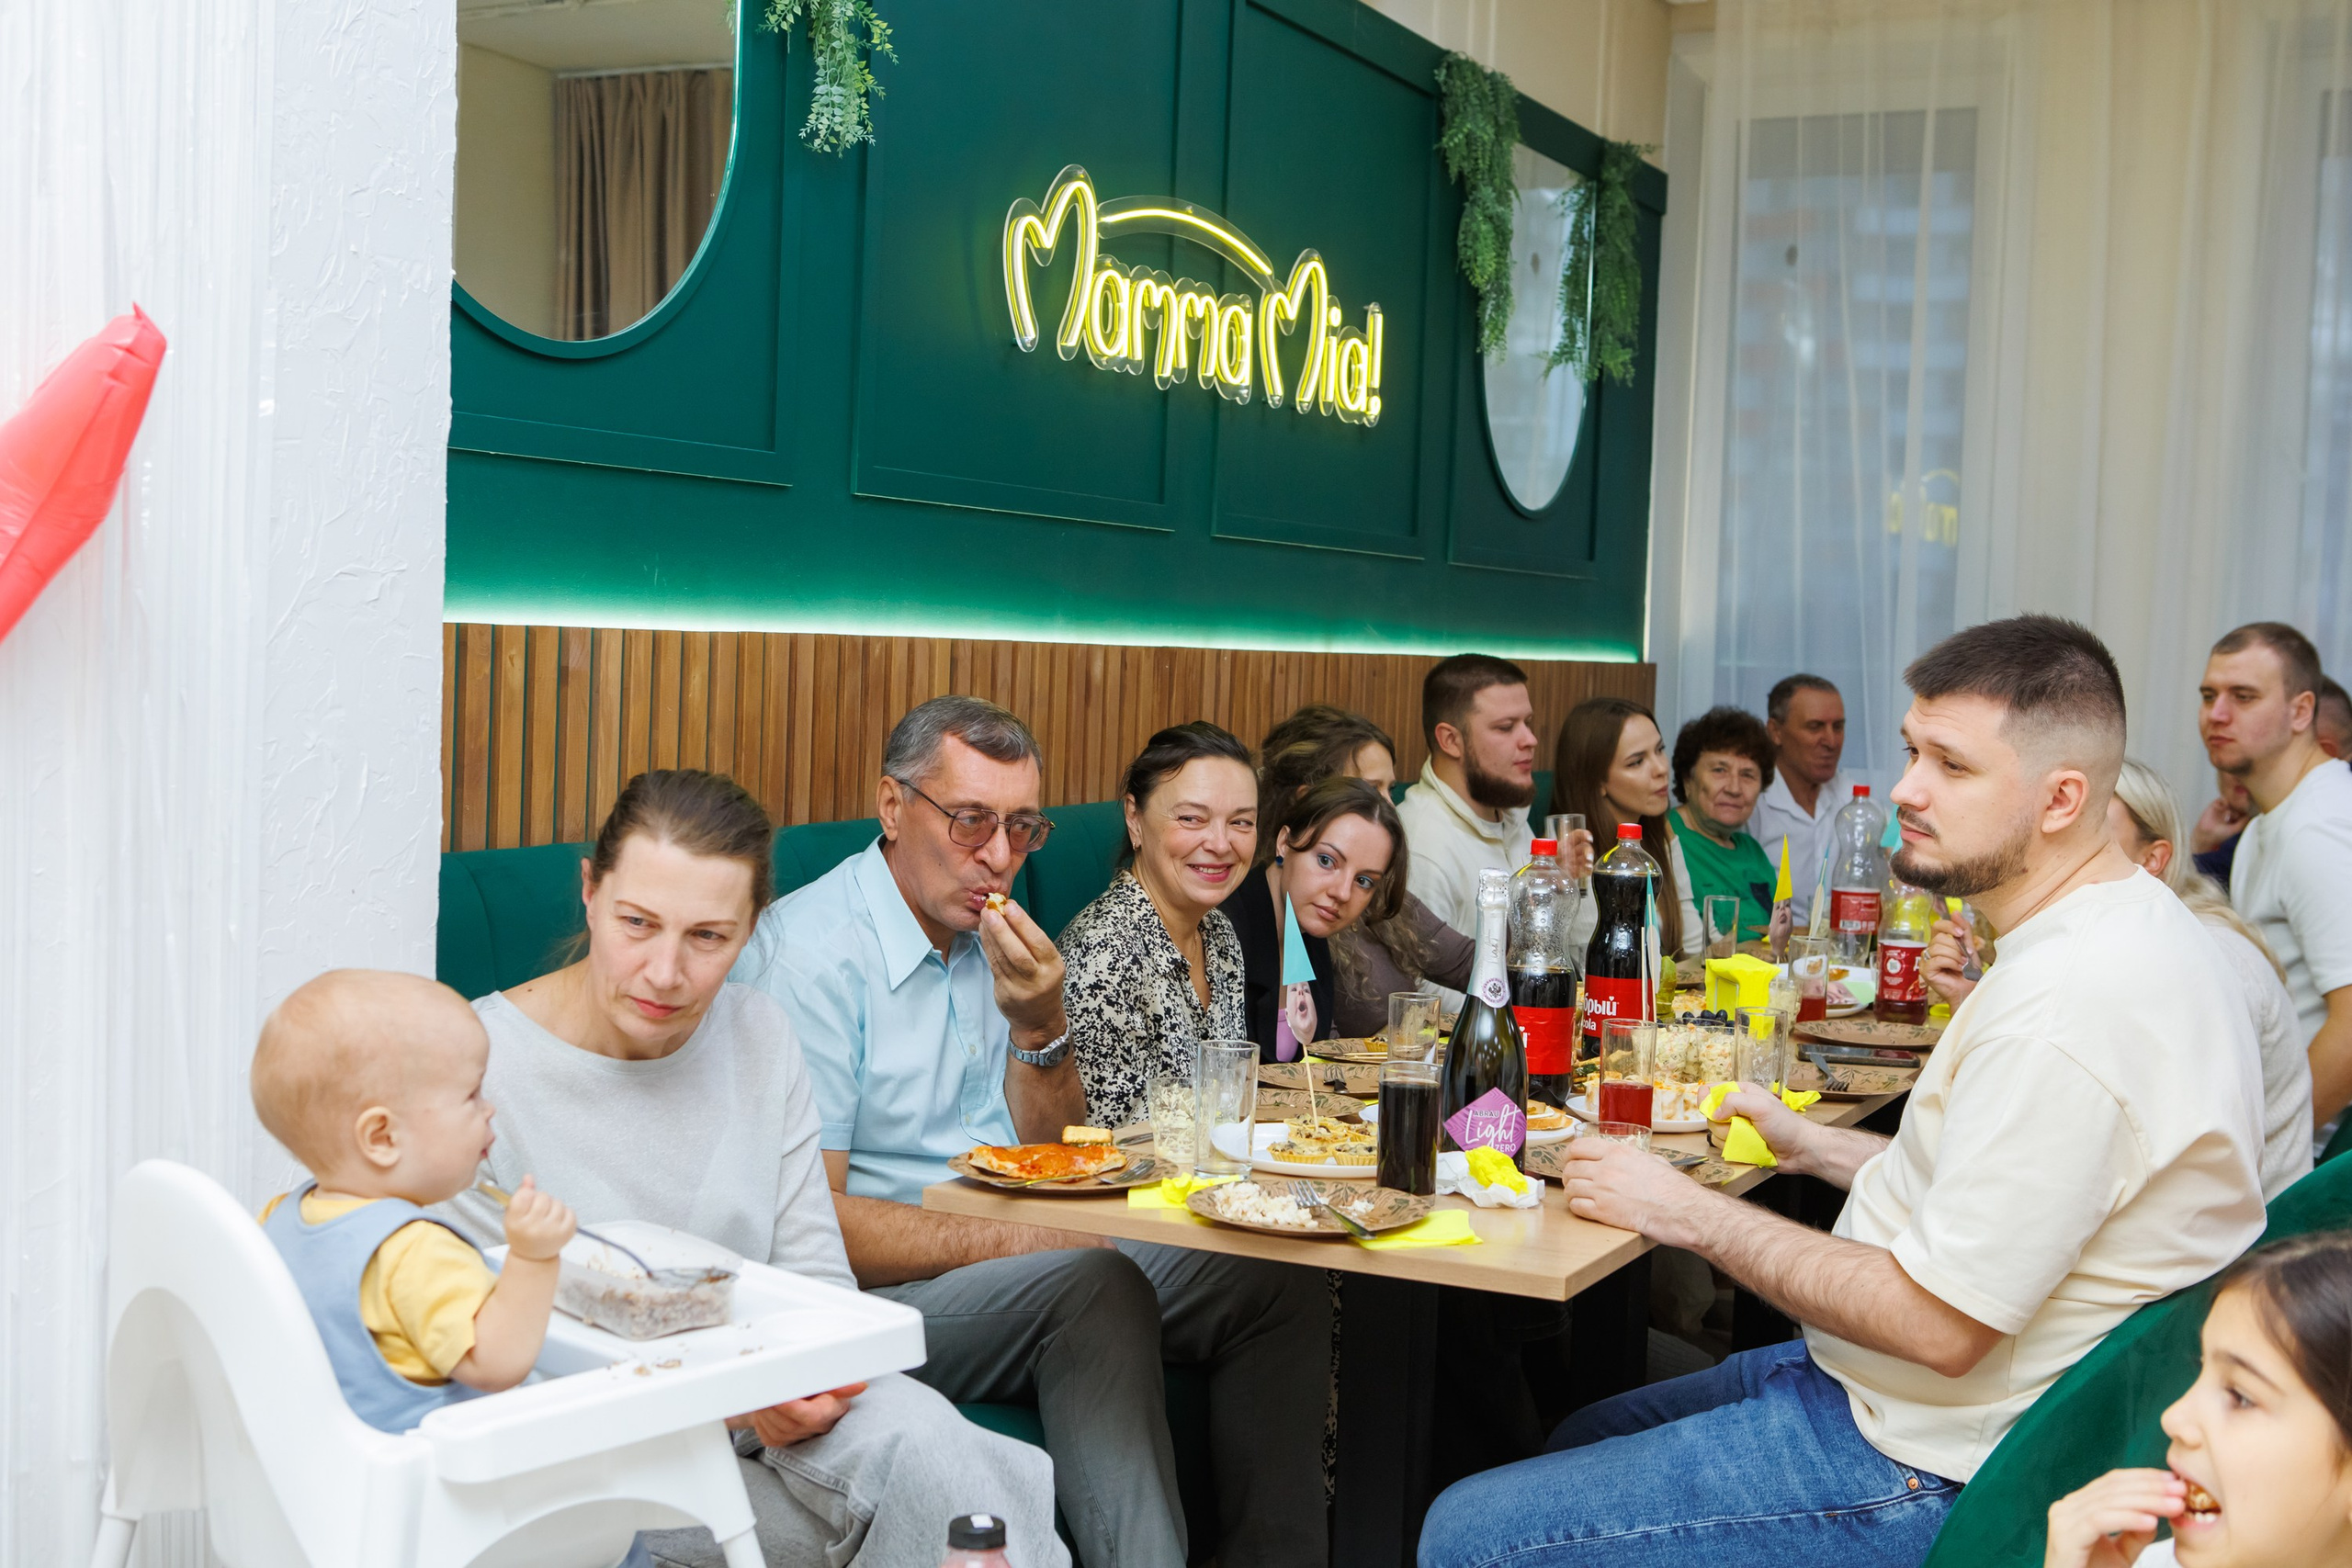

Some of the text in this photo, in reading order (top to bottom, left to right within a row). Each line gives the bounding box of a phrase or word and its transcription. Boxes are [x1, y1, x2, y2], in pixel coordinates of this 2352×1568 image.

[1006, 179, 1385, 416] Mamma Mia!
[1465, 1103, 1521, 1149] Light
[1473, 1110, 1500, 1119] ABRAU
[1495, 1143, 1517, 1153] ZERO
